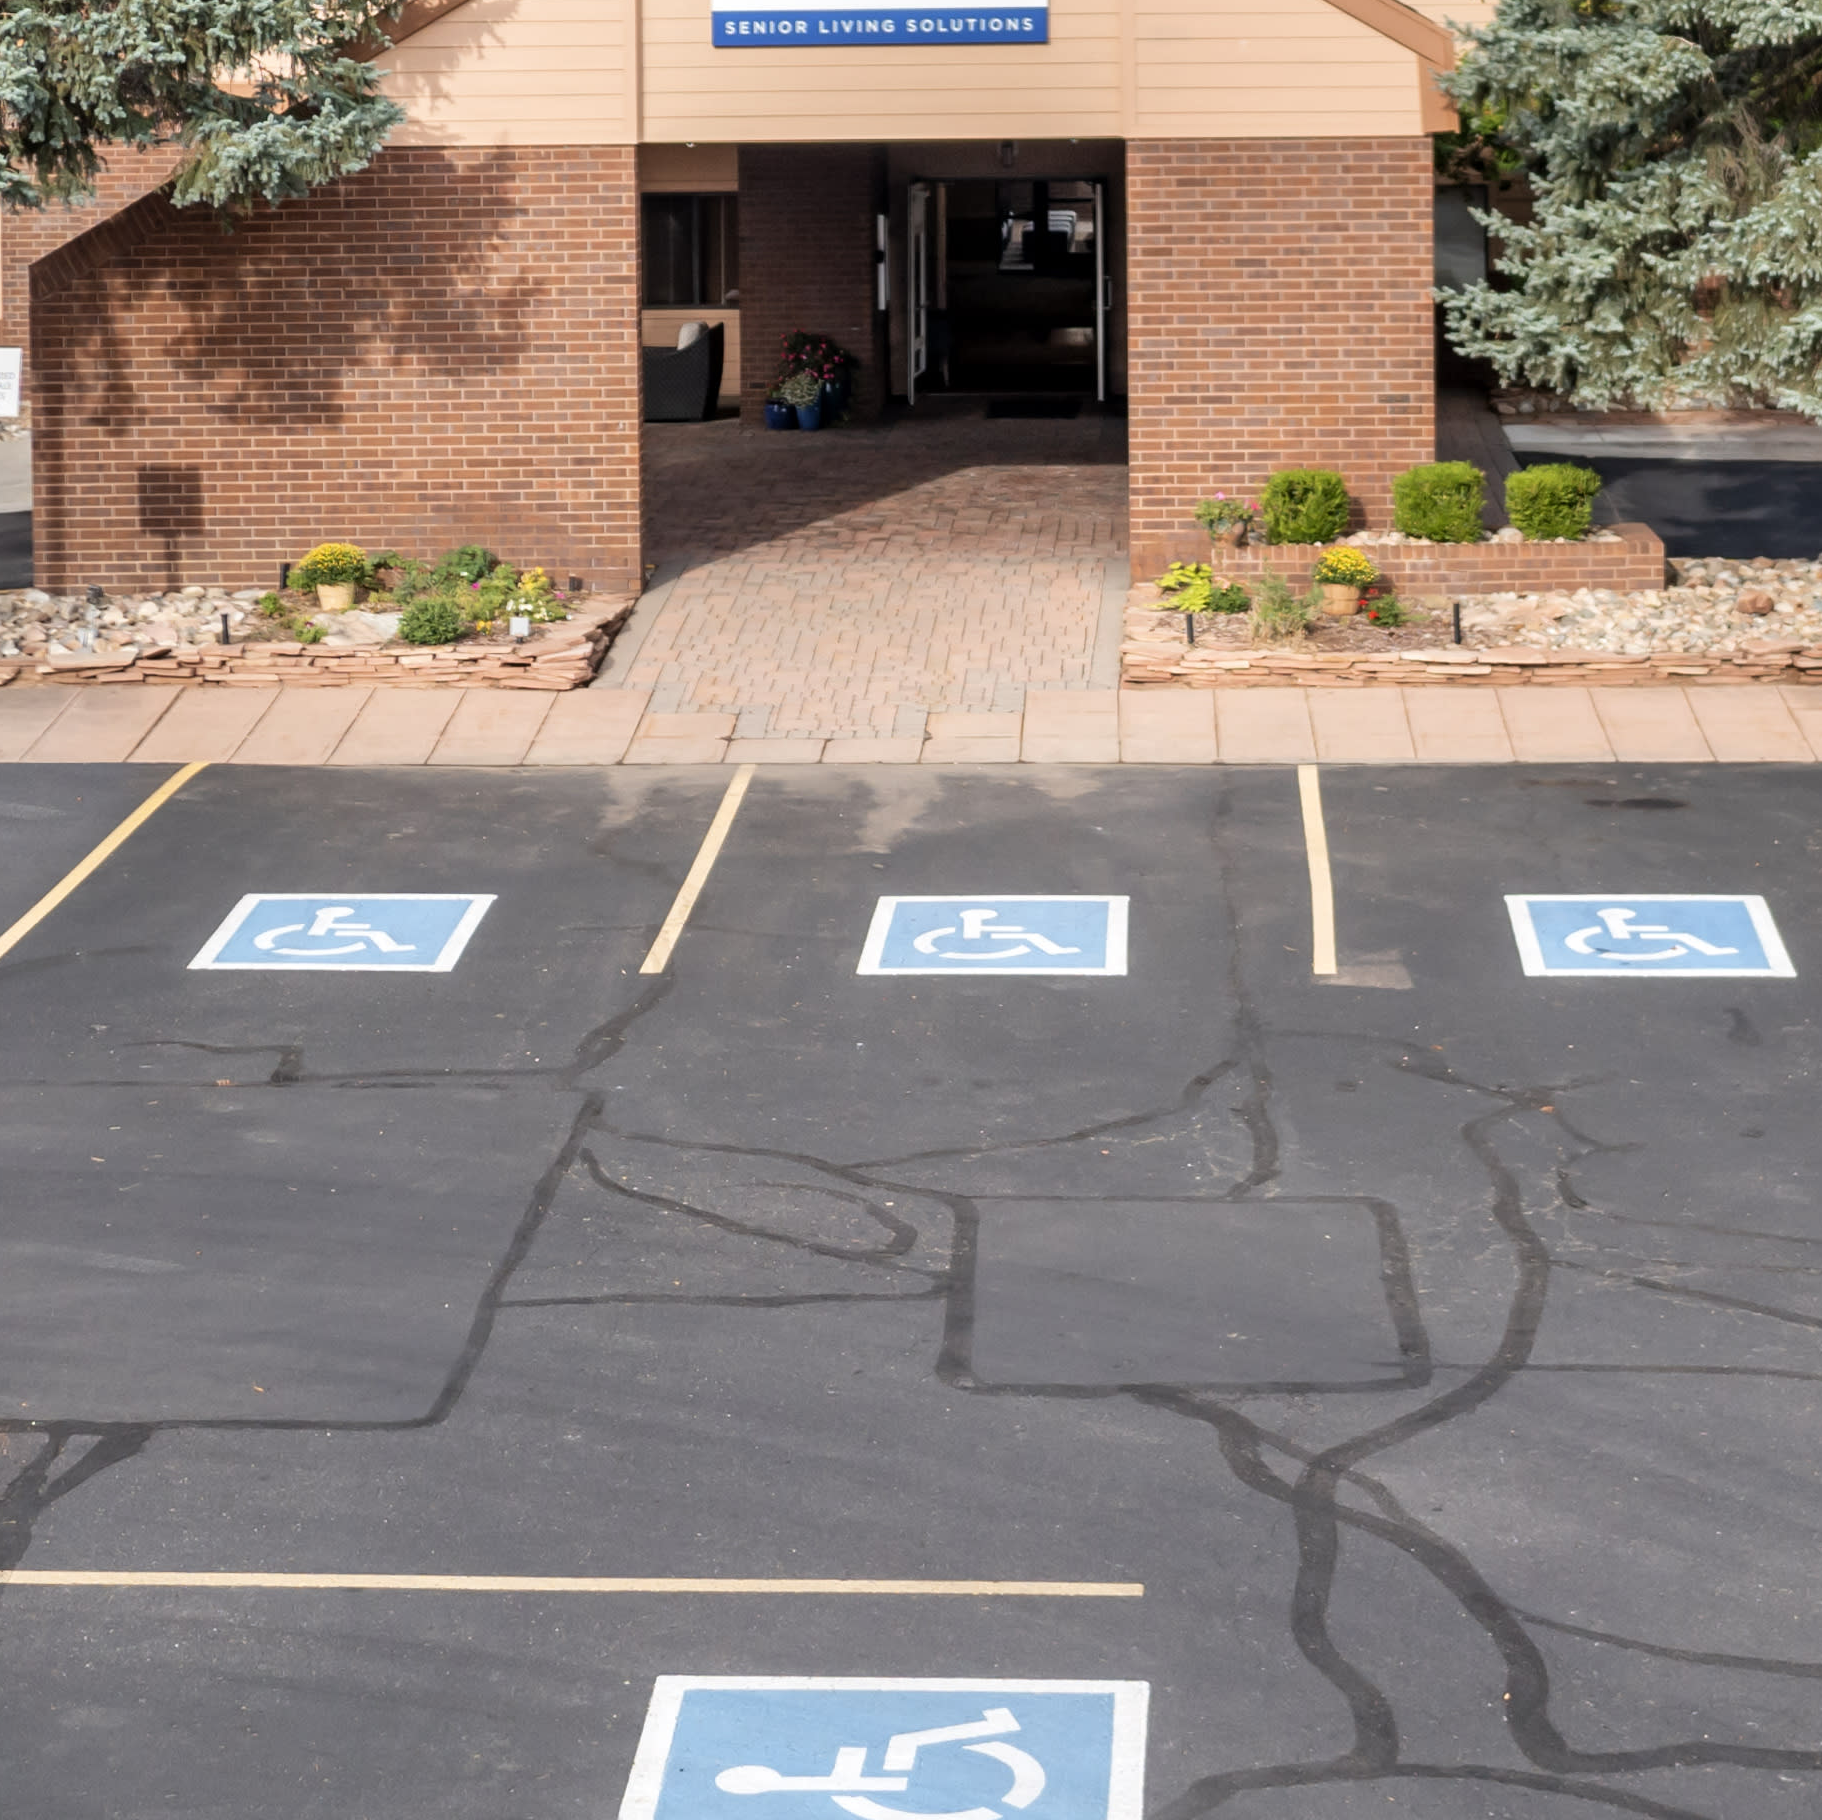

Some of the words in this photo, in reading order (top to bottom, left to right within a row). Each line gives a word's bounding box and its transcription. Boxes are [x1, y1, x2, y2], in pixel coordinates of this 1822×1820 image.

[725, 21, 808, 35] SENIOR
[819, 20, 896, 34] LIVING
[906, 17, 1035, 32] SOLUTIONS
